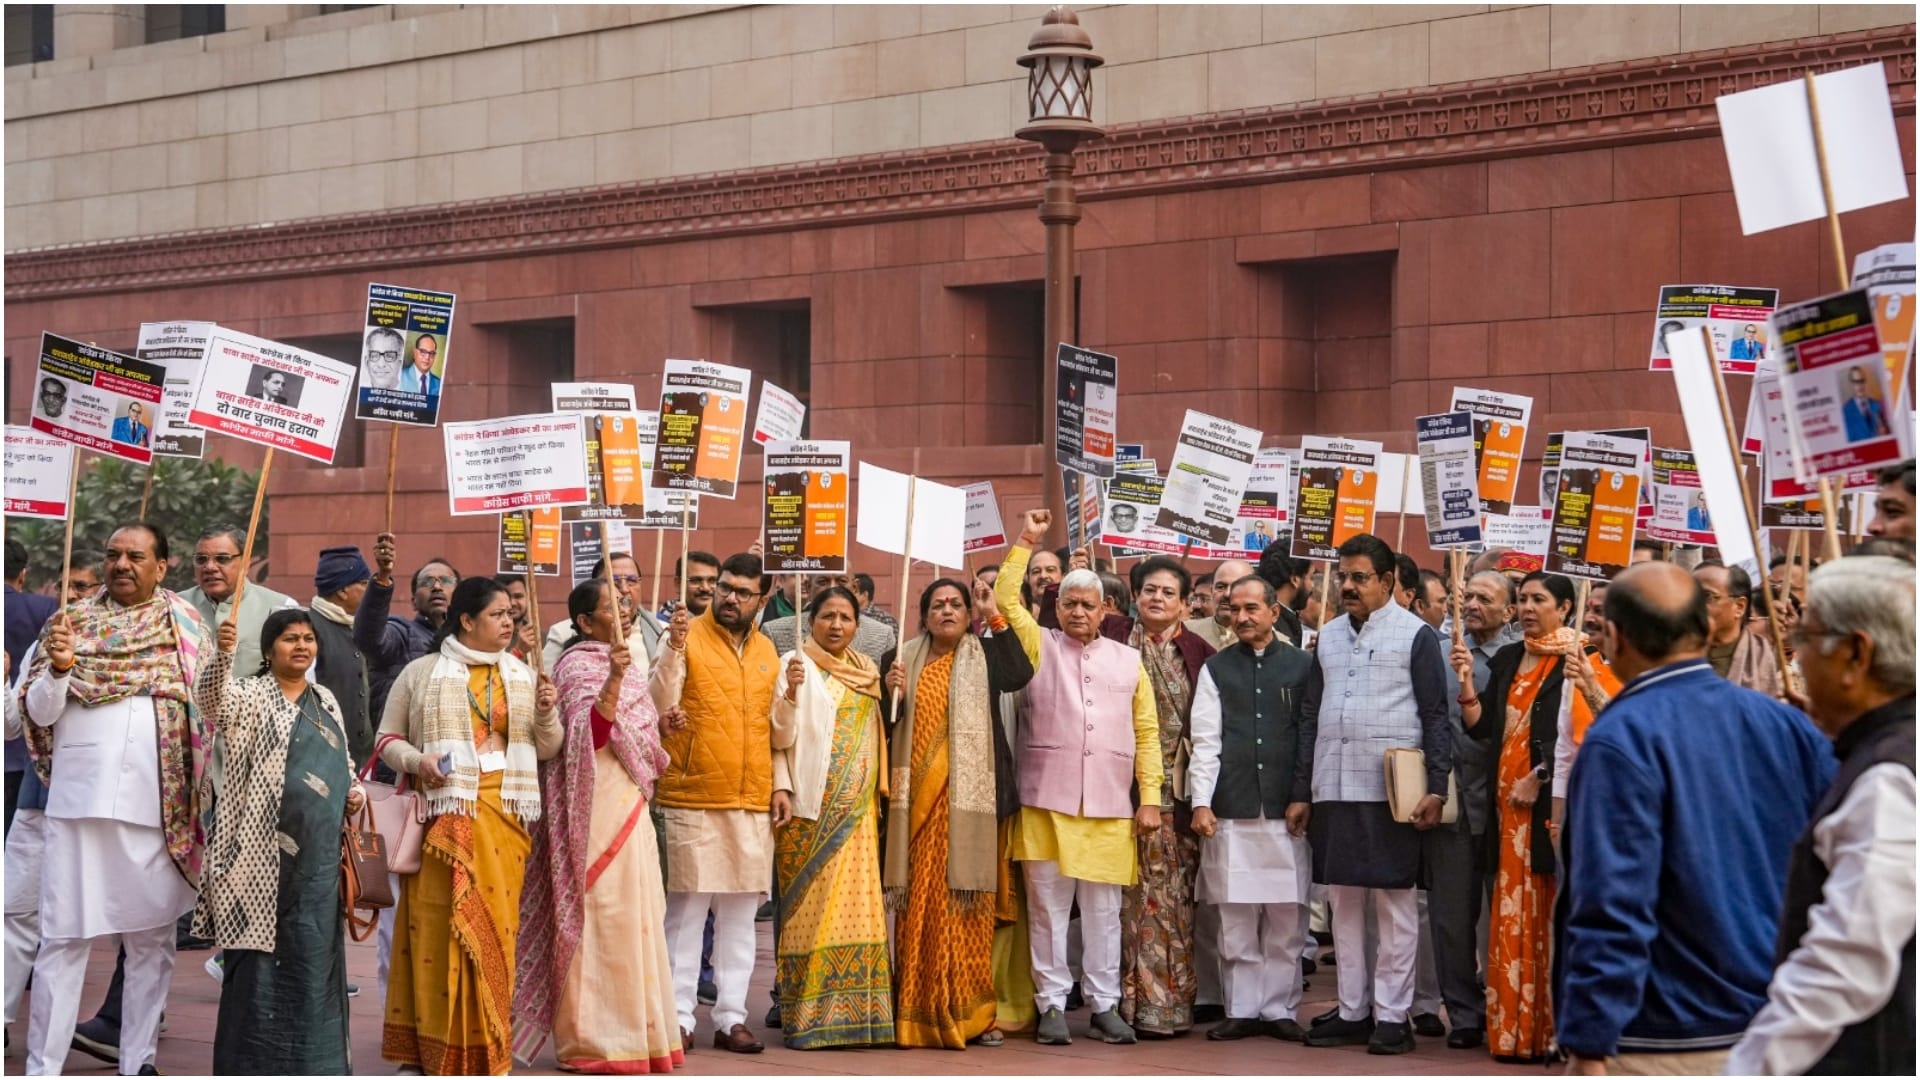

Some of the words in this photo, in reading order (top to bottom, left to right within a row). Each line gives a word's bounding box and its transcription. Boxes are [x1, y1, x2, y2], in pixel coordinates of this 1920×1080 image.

[223, 347, 239, 358] बाबा
[240, 351, 259, 363] साहेब
[293, 365, 303, 375] जी
[304, 368, 314, 378] का
[315, 372, 340, 386] अपमान
[260, 347, 284, 361] कांग्रेस
[284, 351, 292, 362] ने
[293, 354, 312, 367] किया
[216, 390, 235, 402] बाबा
[237, 394, 262, 409] साहेब
[301, 412, 313, 424] जी
[313, 415, 325, 427] को
[216, 401, 230, 414] दो
[231, 405, 251, 420] बार
[253, 411, 287, 429] चुनाव
[288, 422, 319, 439] हराया
[220, 418, 249, 434] कांग्रेस
[249, 428, 274, 441] माफी
[454, 431, 474, 441] कांग्रेस
[476, 431, 482, 439] ने
[482, 429, 499, 439] किया
[553, 422, 576, 431] अपमान
[483, 495, 509, 509] कांग्रेस
[511, 494, 532, 506] माफी
